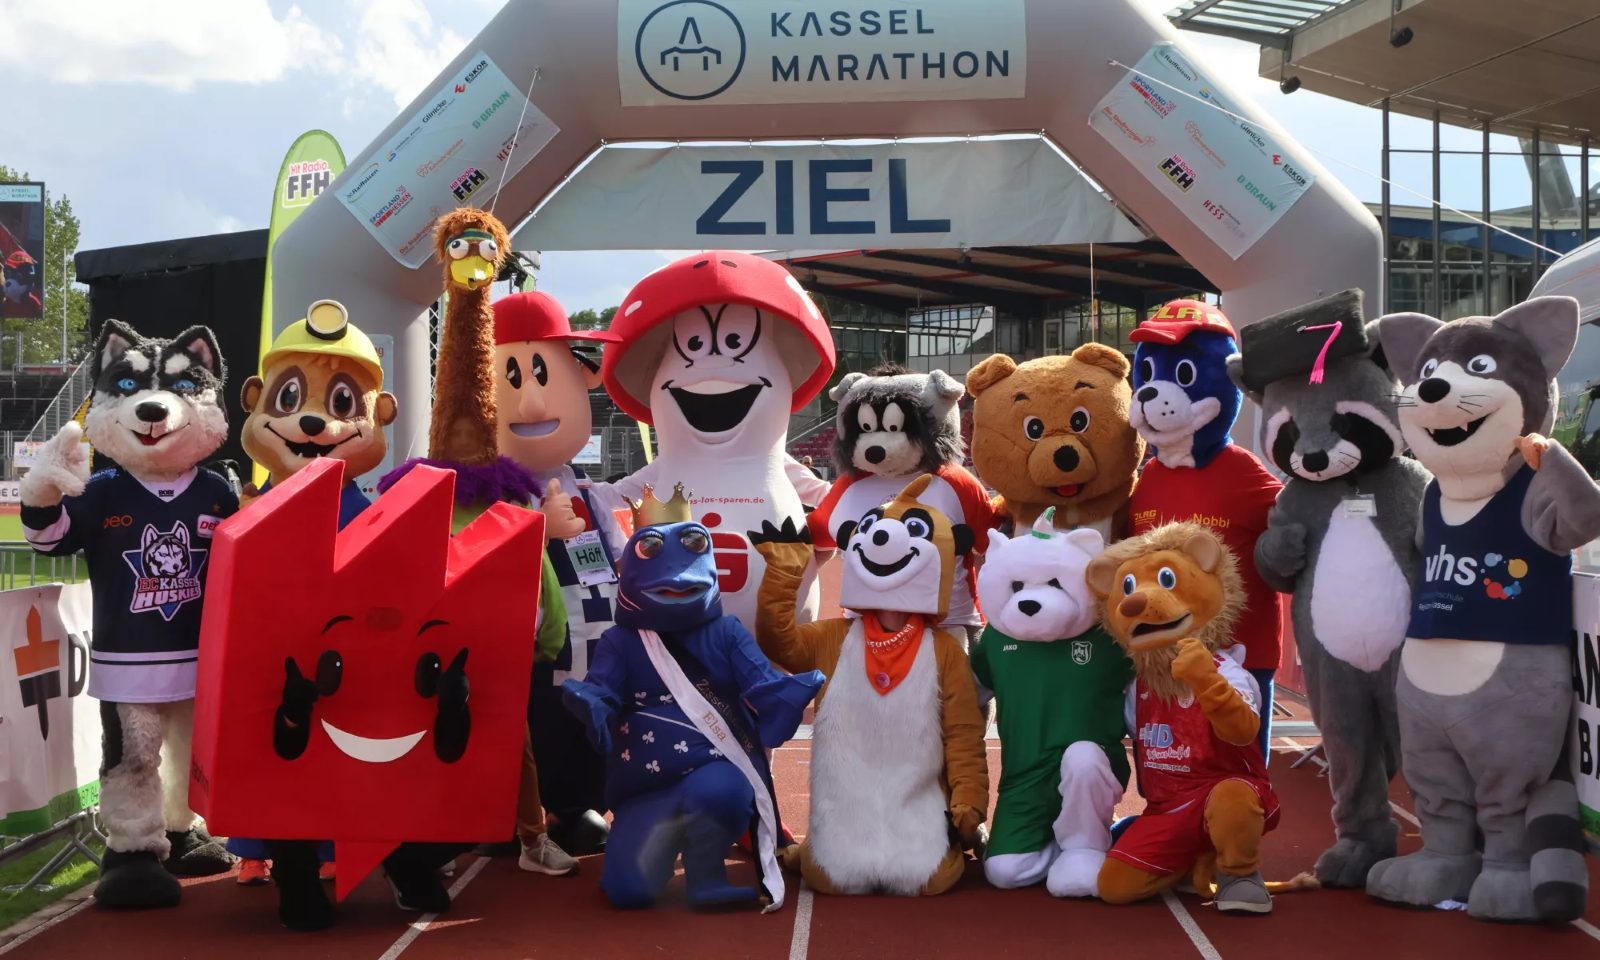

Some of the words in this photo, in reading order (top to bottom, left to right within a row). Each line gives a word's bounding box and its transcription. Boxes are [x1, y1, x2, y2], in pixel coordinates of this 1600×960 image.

[770, 9, 935, 37] KASSEL
[463, 59, 488, 83] ESKOR
[771, 49, 1009, 82] MARATHON
[1133, 74, 1166, 105] SPORTLAND
[302, 161, 328, 173] Radio
[1160, 157, 1194, 190] FFH
[287, 170, 330, 200] FFH
[452, 168, 485, 200] FFH
[696, 158, 951, 235] ZIEL
[1201, 197, 1225, 221] HESS
[1192, 512, 1230, 529] Nobbi
[1425, 544, 1478, 586] vhs
[132, 586, 200, 611] HUSKIES
[139, 577, 159, 591] EC
[159, 577, 199, 591] KASSEL
[1003, 644, 1018, 652] JAKO
[703, 711, 727, 742] Elsa
